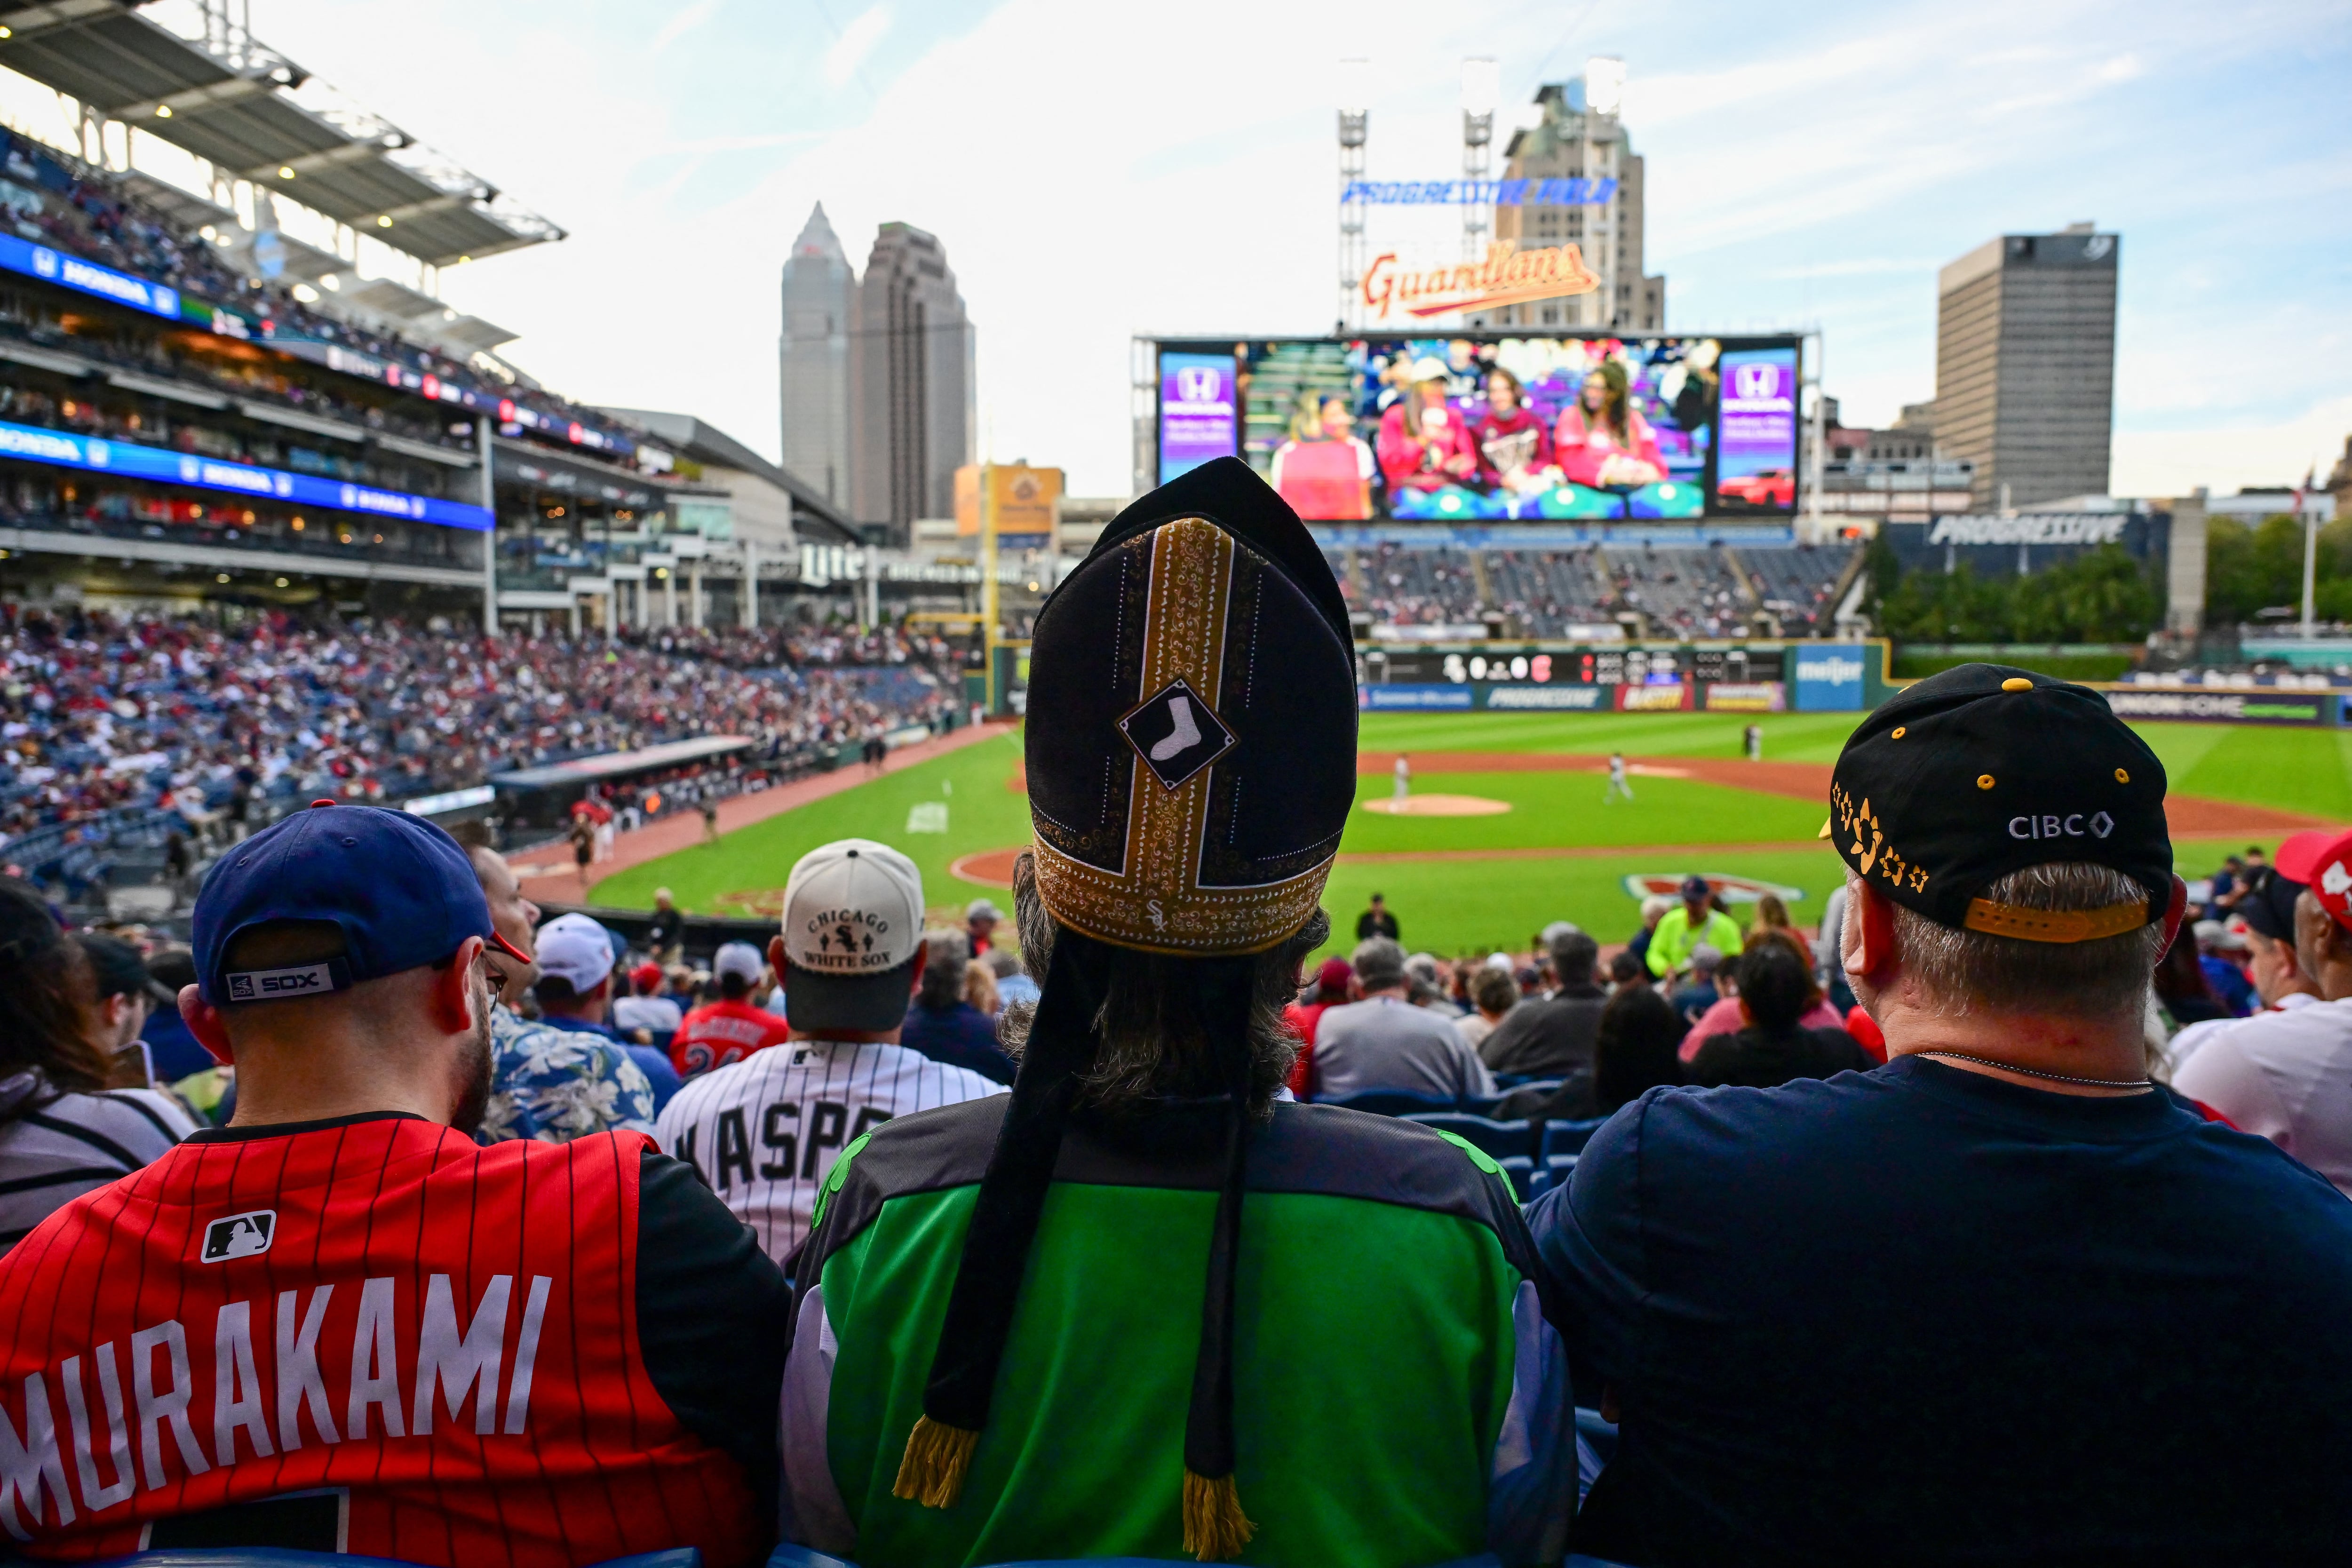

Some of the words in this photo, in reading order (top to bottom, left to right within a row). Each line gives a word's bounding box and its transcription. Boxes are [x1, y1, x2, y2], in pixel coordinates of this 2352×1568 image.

[1360, 239, 1600, 318] Guardians
[1929, 515, 2129, 545] PROGRESSIVE
[1797, 656, 1865, 686] meijer
[2009, 814, 2084, 839] CIBC
[808, 908, 889, 933] CHICAGO
[804, 951, 857, 967] WHITE
[861, 951, 891, 967] SOX
[261, 972, 319, 992] SOX
[0, 1273, 553, 1541] MURAKAMI
